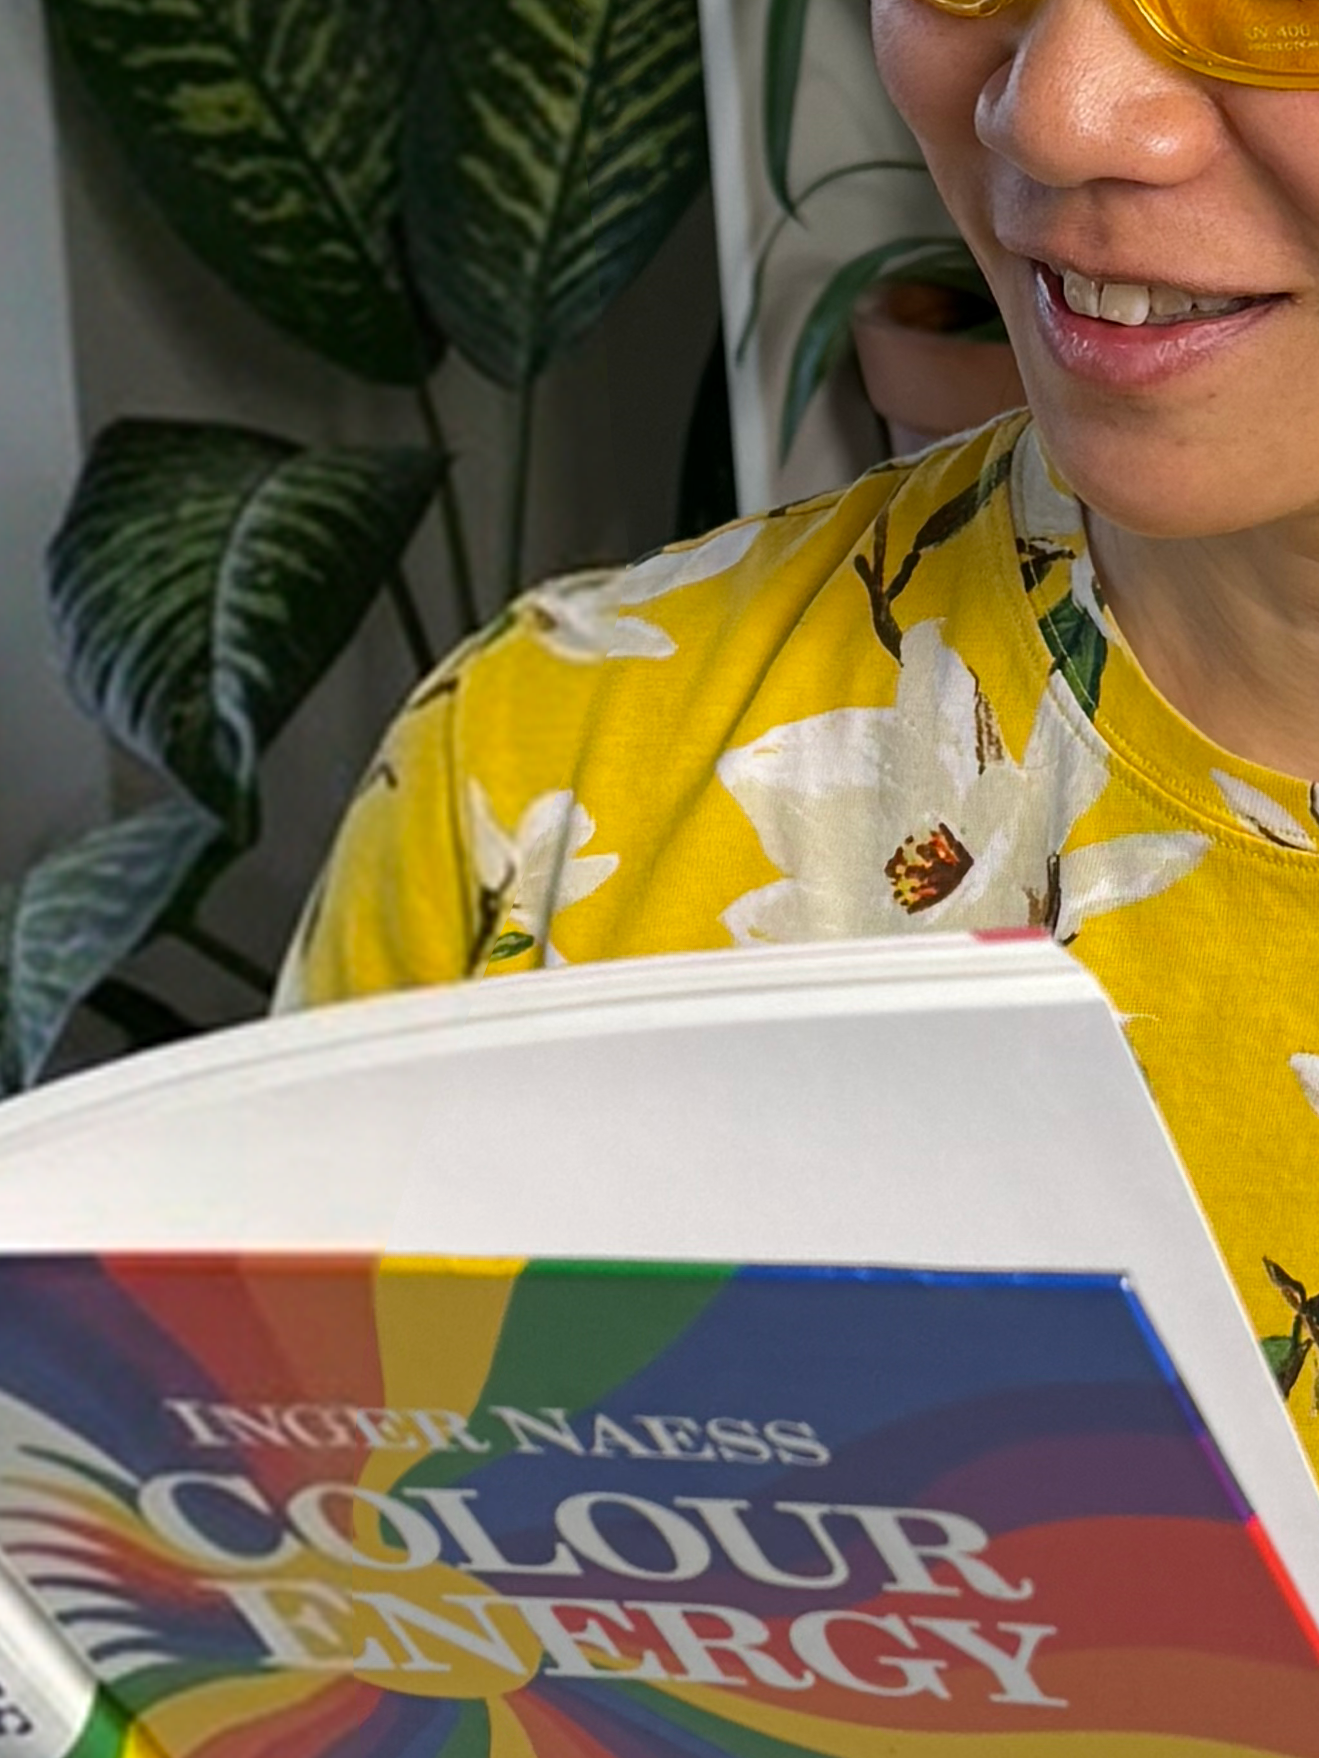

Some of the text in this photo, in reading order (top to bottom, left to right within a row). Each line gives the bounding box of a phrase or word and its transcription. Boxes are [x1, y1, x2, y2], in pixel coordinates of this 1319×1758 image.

[165, 1398, 832, 1468] INGER NAESS
[137, 1471, 1037, 1602] COLOUR
[231, 1578, 1069, 1710] ENERGY
